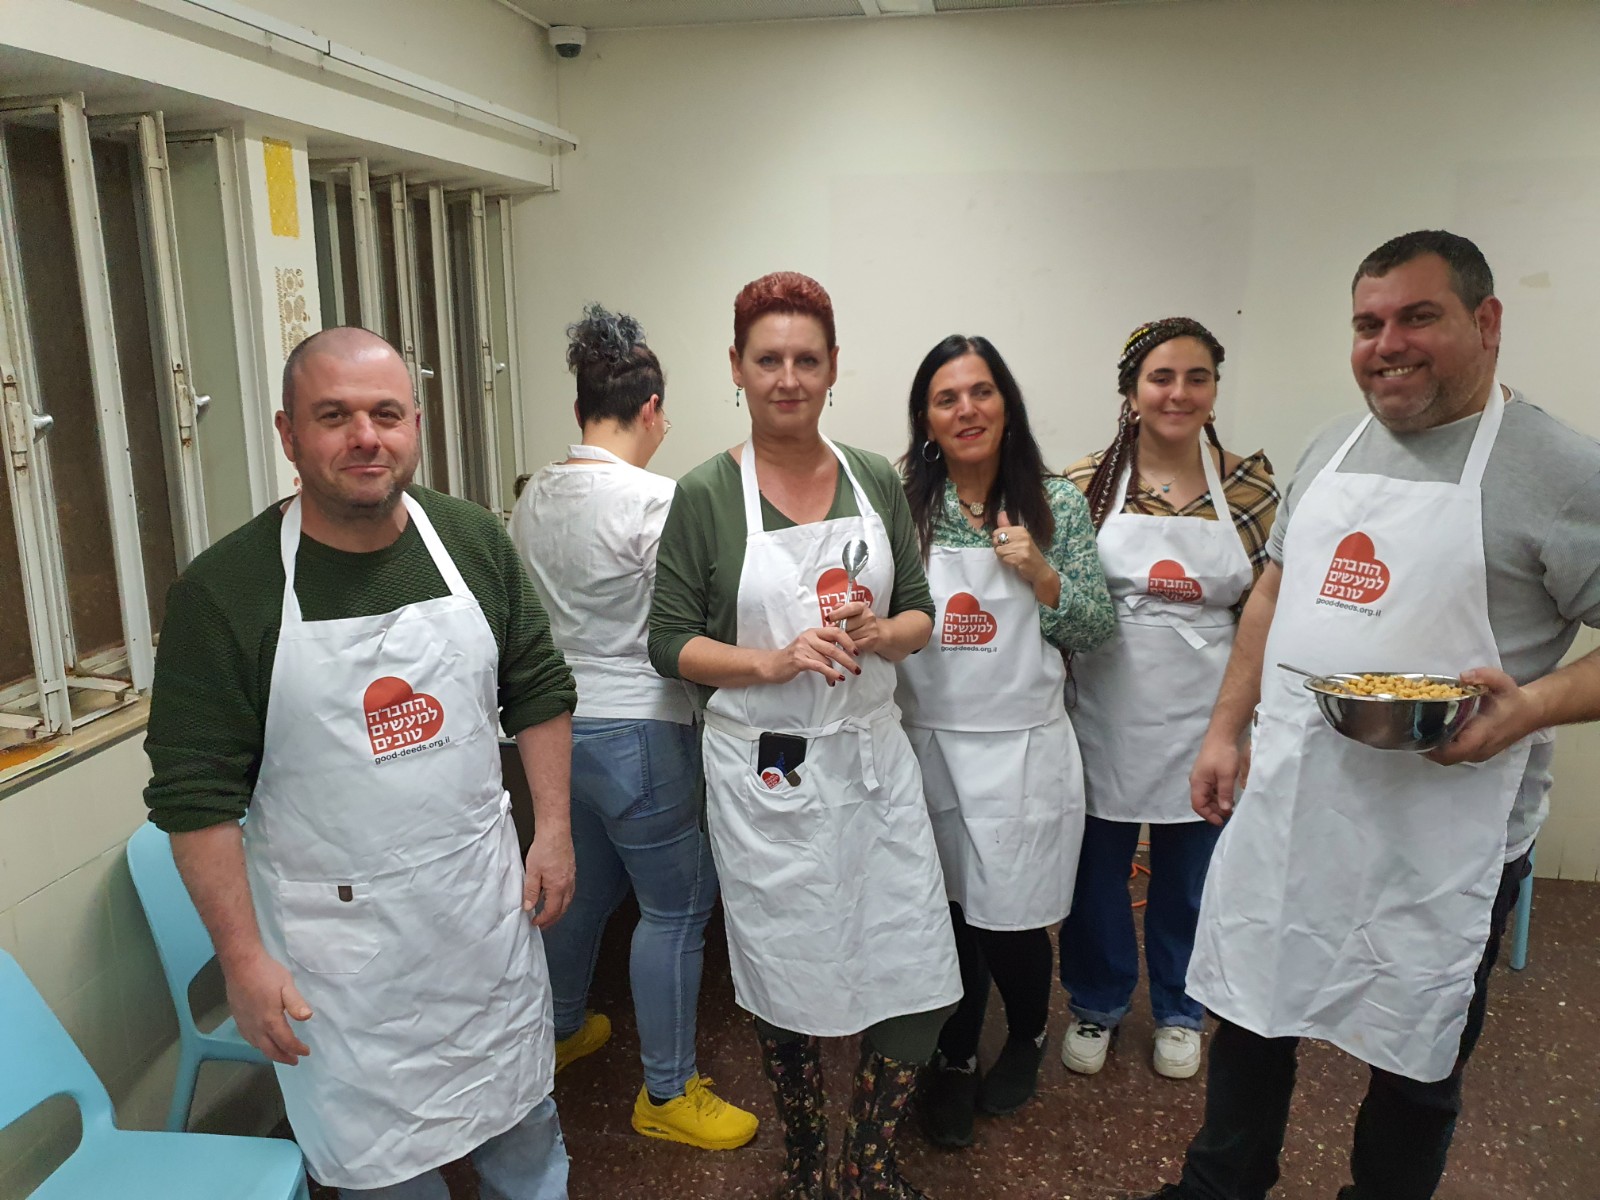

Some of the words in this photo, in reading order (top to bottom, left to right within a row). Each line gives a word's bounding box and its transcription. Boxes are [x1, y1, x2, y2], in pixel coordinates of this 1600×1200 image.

[1328, 570, 1384, 590] למעשים
[1323, 583, 1363, 599] טובים
[1316, 598, 1381, 616] good-deeds.org.il
[944, 621, 993, 633] למעשים
[943, 633, 979, 643] טובים
[370, 707, 438, 736] למעשים
[373, 728, 422, 751] טובים
[374, 736, 450, 765] good-deeds.org.il
